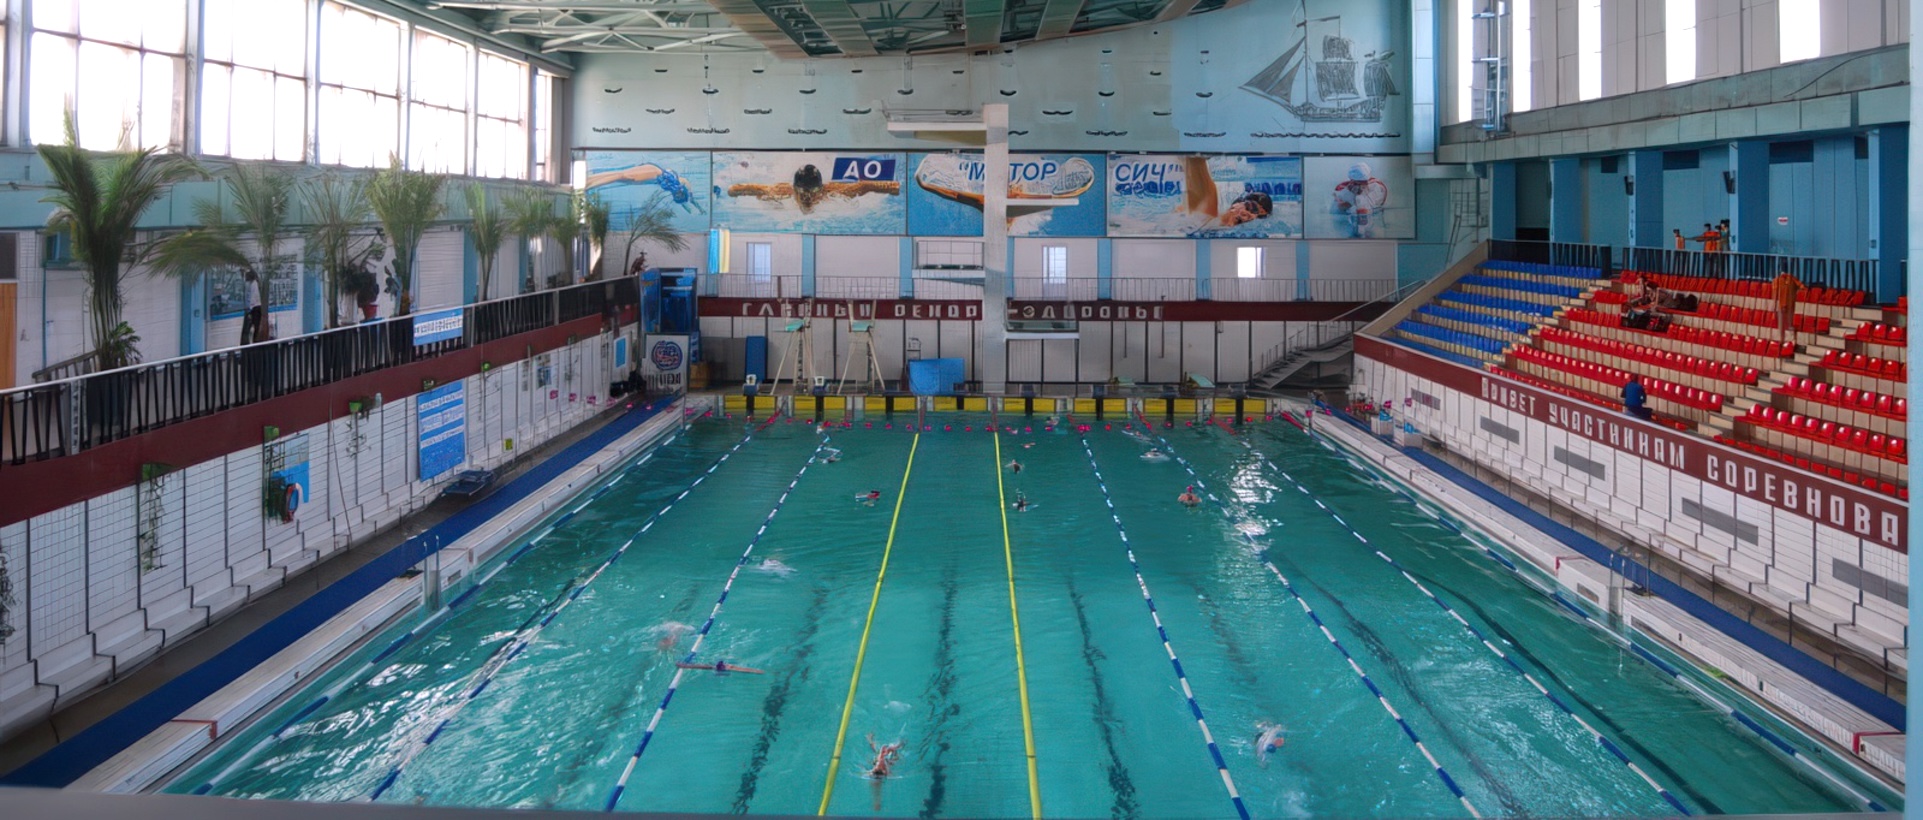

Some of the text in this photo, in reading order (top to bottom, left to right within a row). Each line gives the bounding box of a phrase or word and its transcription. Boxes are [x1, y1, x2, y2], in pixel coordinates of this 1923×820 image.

[842, 160, 882, 180] АО
[959, 162, 1057, 181] "МТОР
[1548, 401, 1685, 470] УЧАСТНИКАМ
